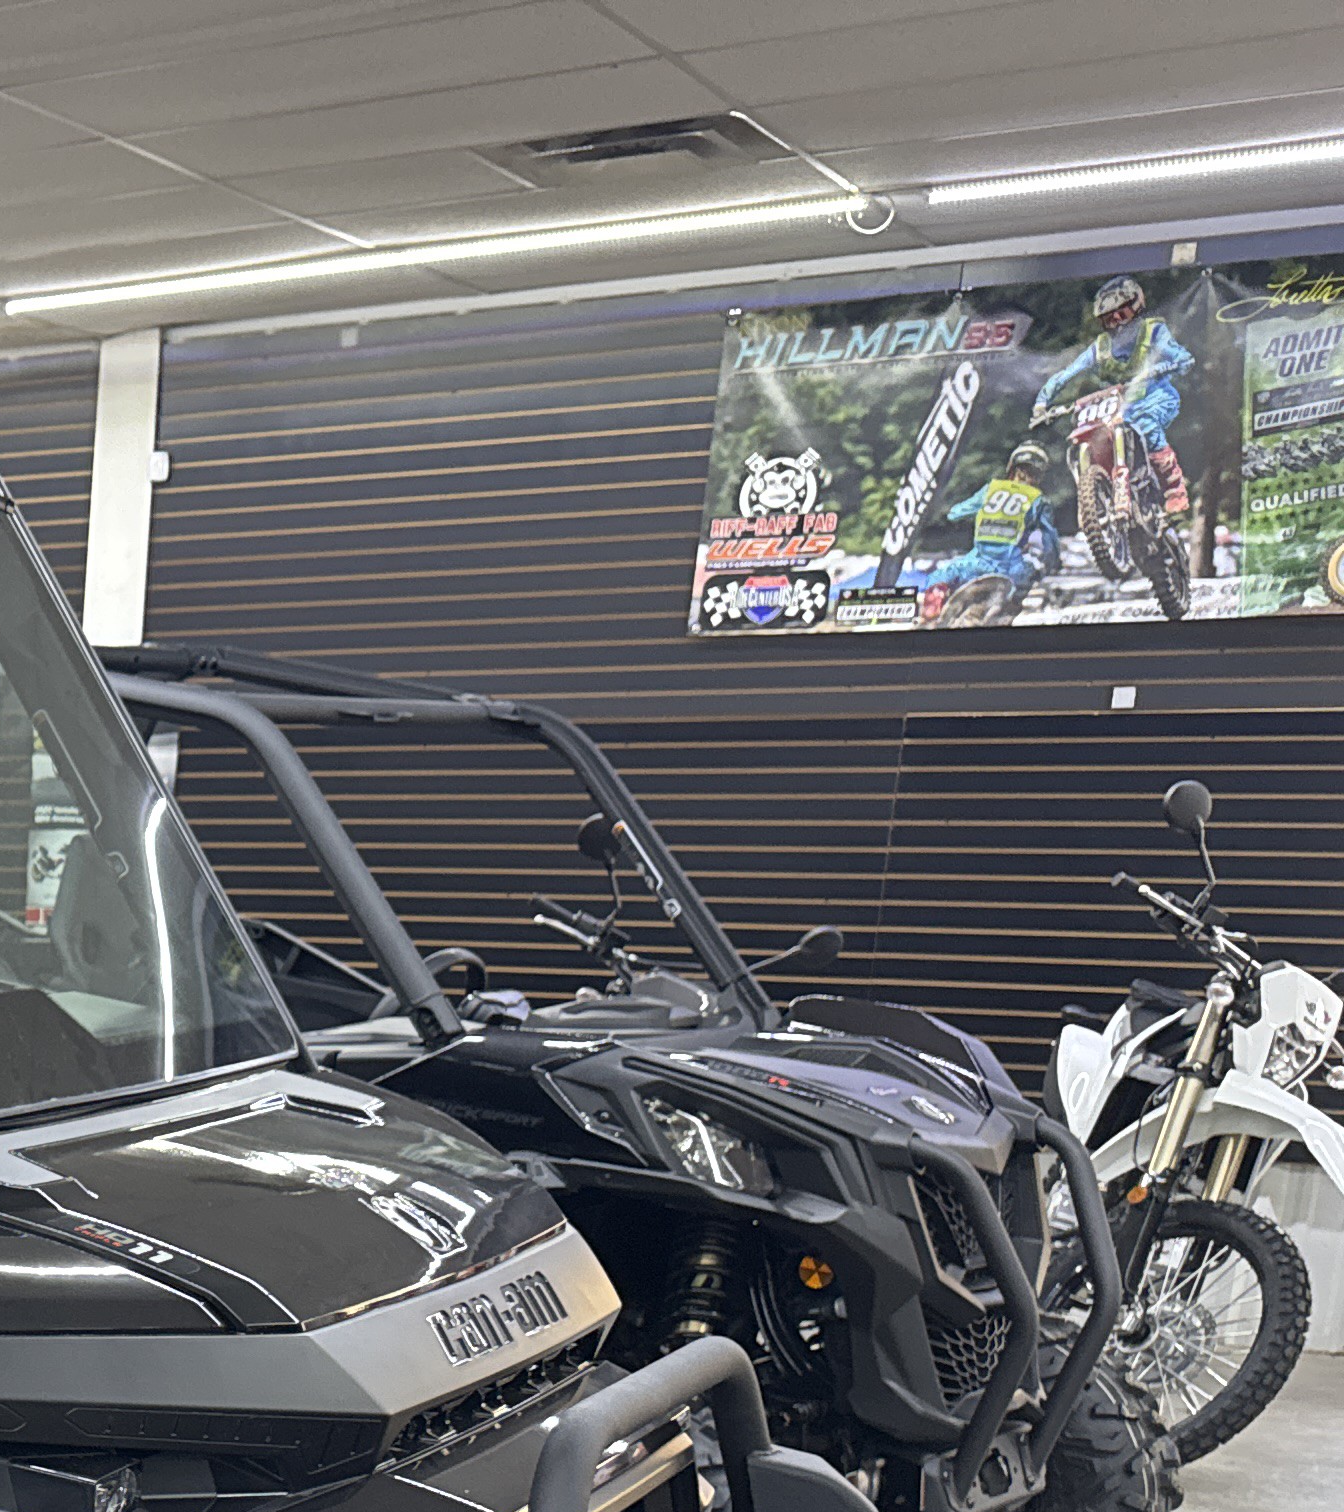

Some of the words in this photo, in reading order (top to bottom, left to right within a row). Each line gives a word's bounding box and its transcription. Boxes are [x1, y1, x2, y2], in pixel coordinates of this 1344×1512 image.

[734, 315, 969, 369] HILLMAN
[1262, 324, 1344, 359] ADMIT
[1279, 350, 1330, 377] ONE
[983, 489, 1029, 517] 96
[705, 534, 836, 561] WELLS
[425, 1270, 568, 1367] can-am
